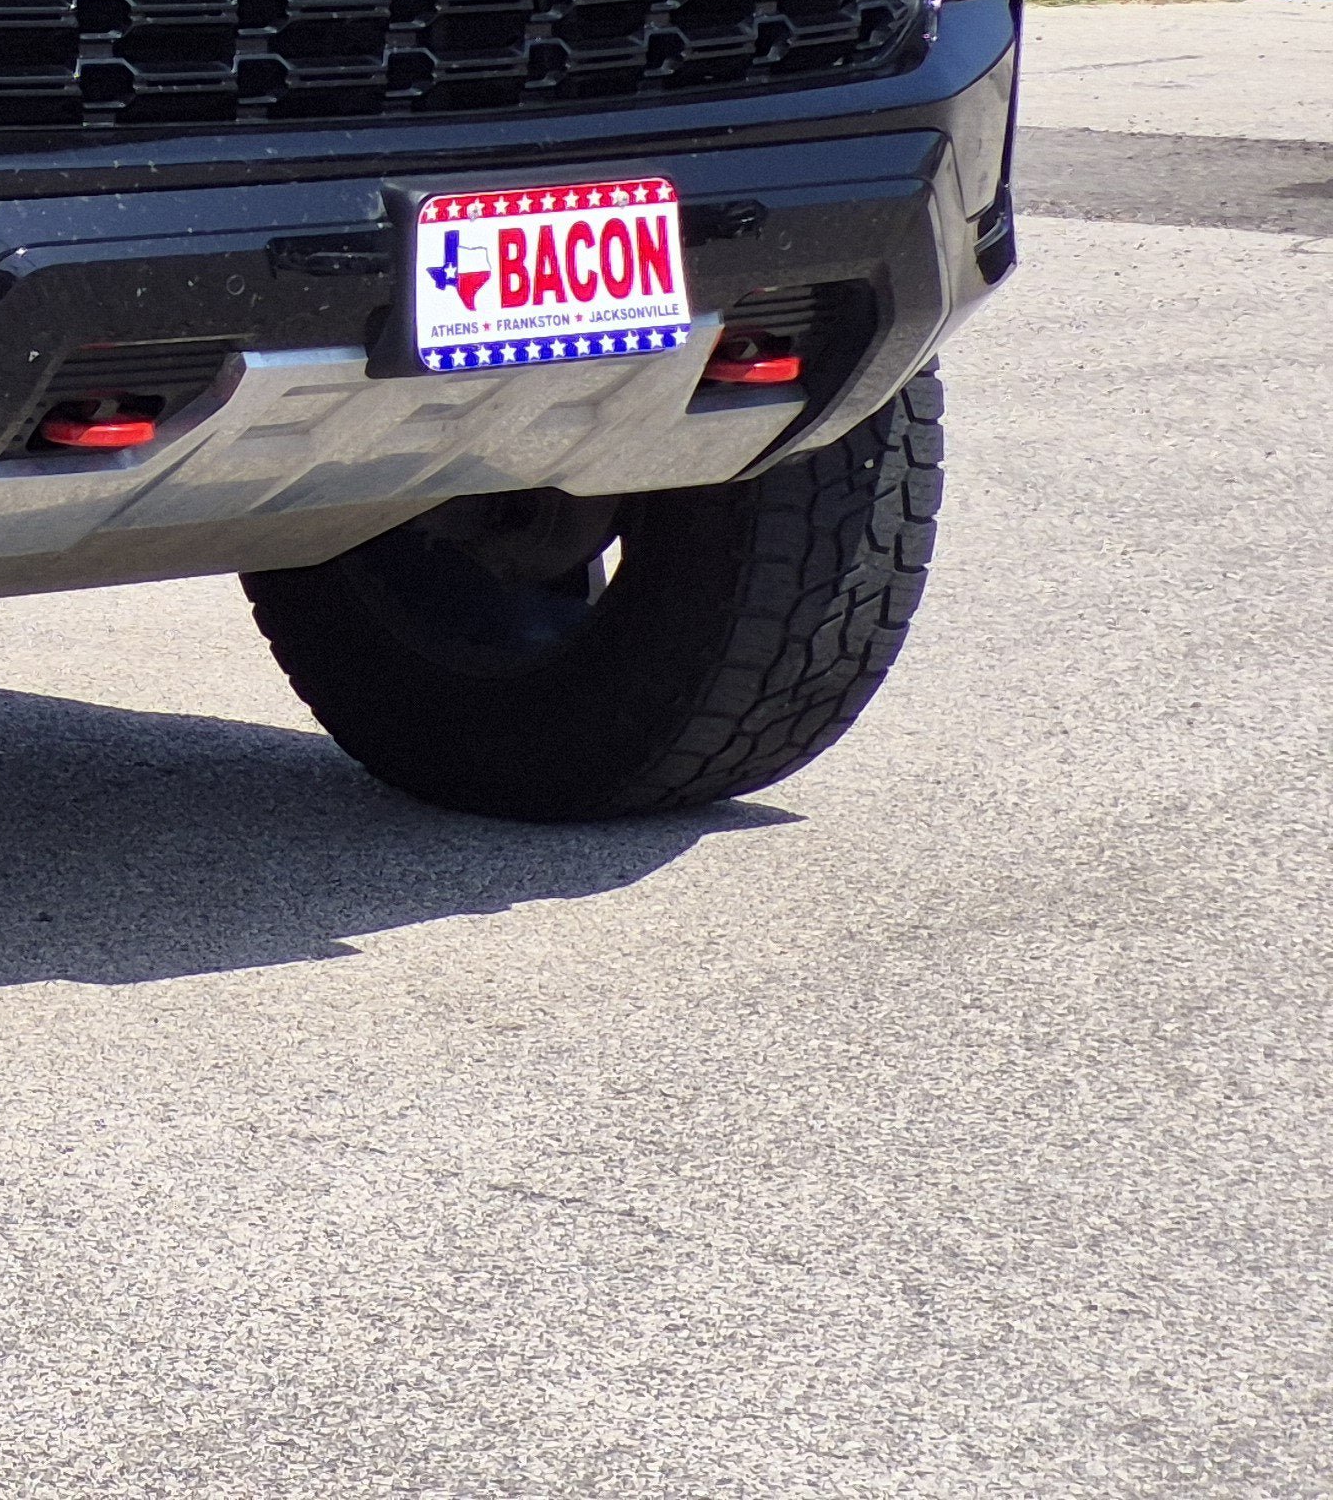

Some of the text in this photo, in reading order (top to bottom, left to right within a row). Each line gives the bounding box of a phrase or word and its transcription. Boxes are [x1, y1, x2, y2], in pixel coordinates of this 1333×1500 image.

[497, 215, 675, 309] BACON
[430, 303, 680, 338] ATHENS FRANKSTON JACKSONVILLE
